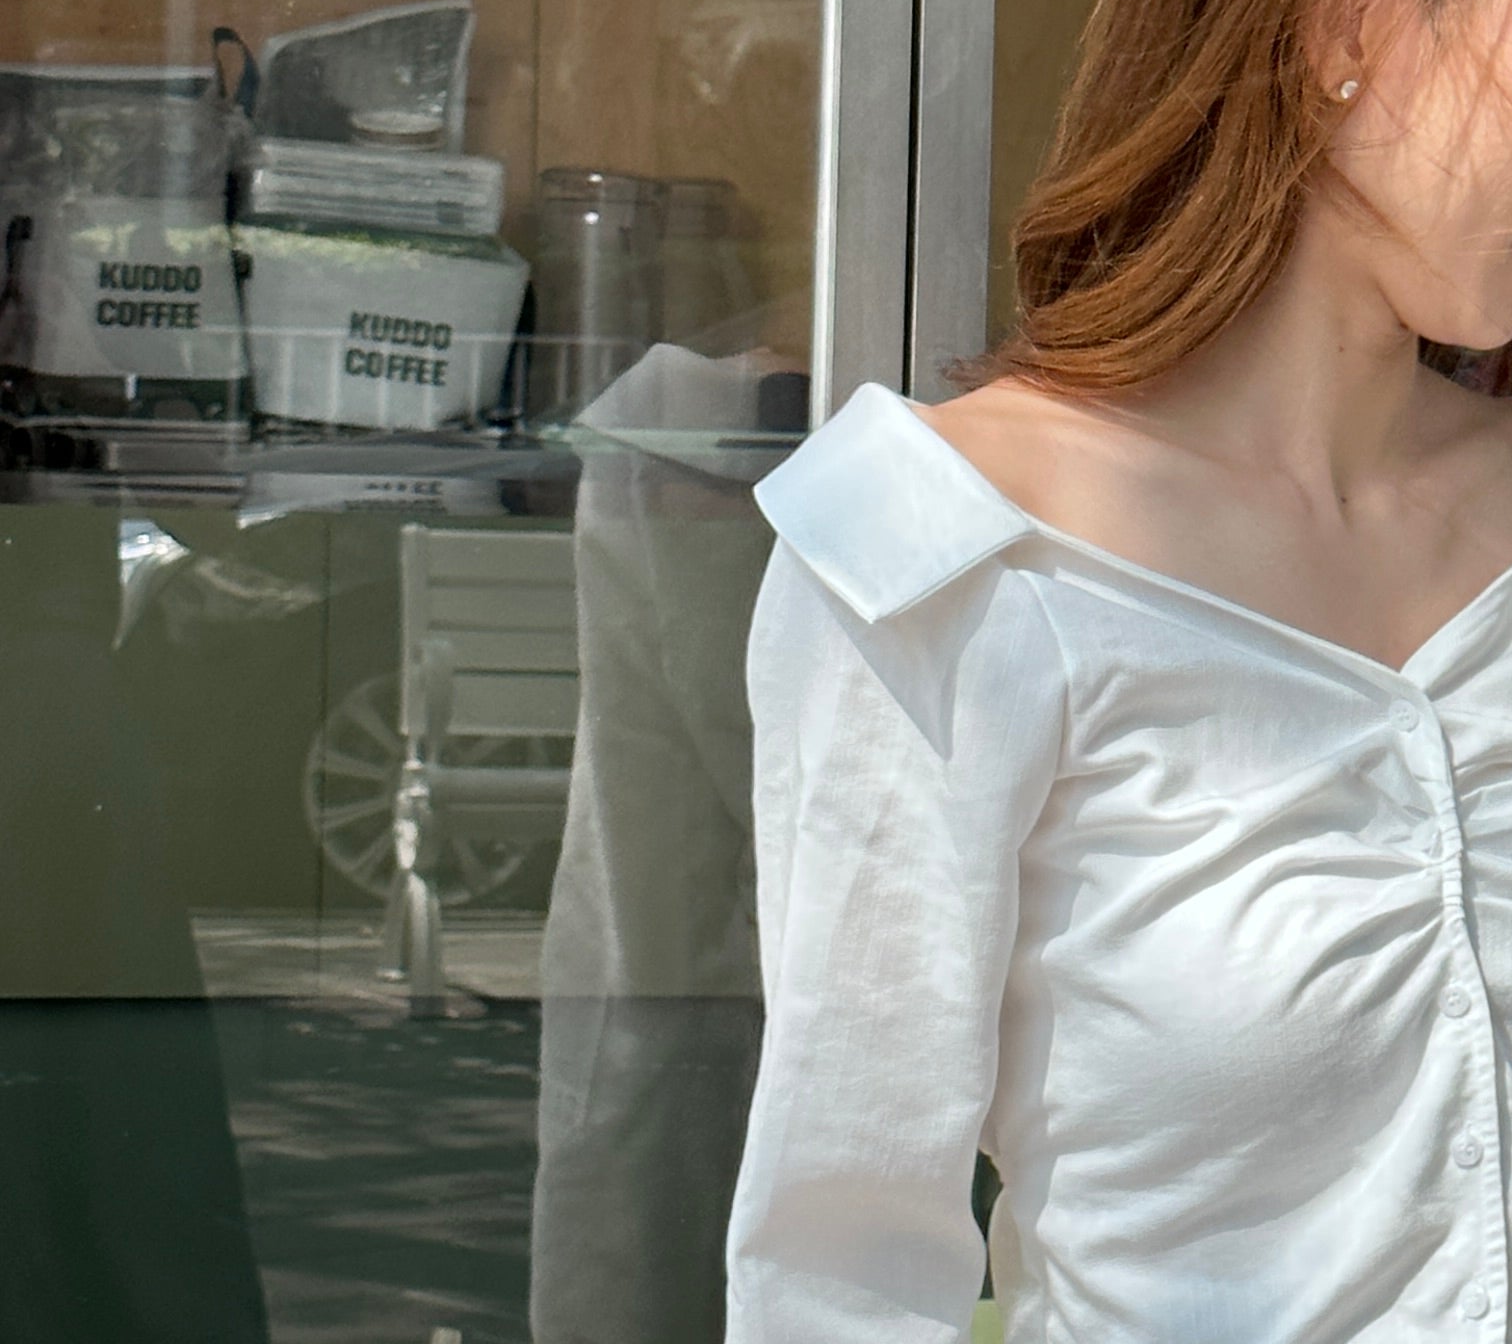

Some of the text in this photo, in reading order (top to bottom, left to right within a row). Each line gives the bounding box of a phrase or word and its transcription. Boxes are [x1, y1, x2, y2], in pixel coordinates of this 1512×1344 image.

[99, 262, 202, 291] KUDDO
[97, 299, 201, 329] COFFEE
[350, 312, 452, 350] KUDDO
[346, 348, 449, 386] COFFEE
